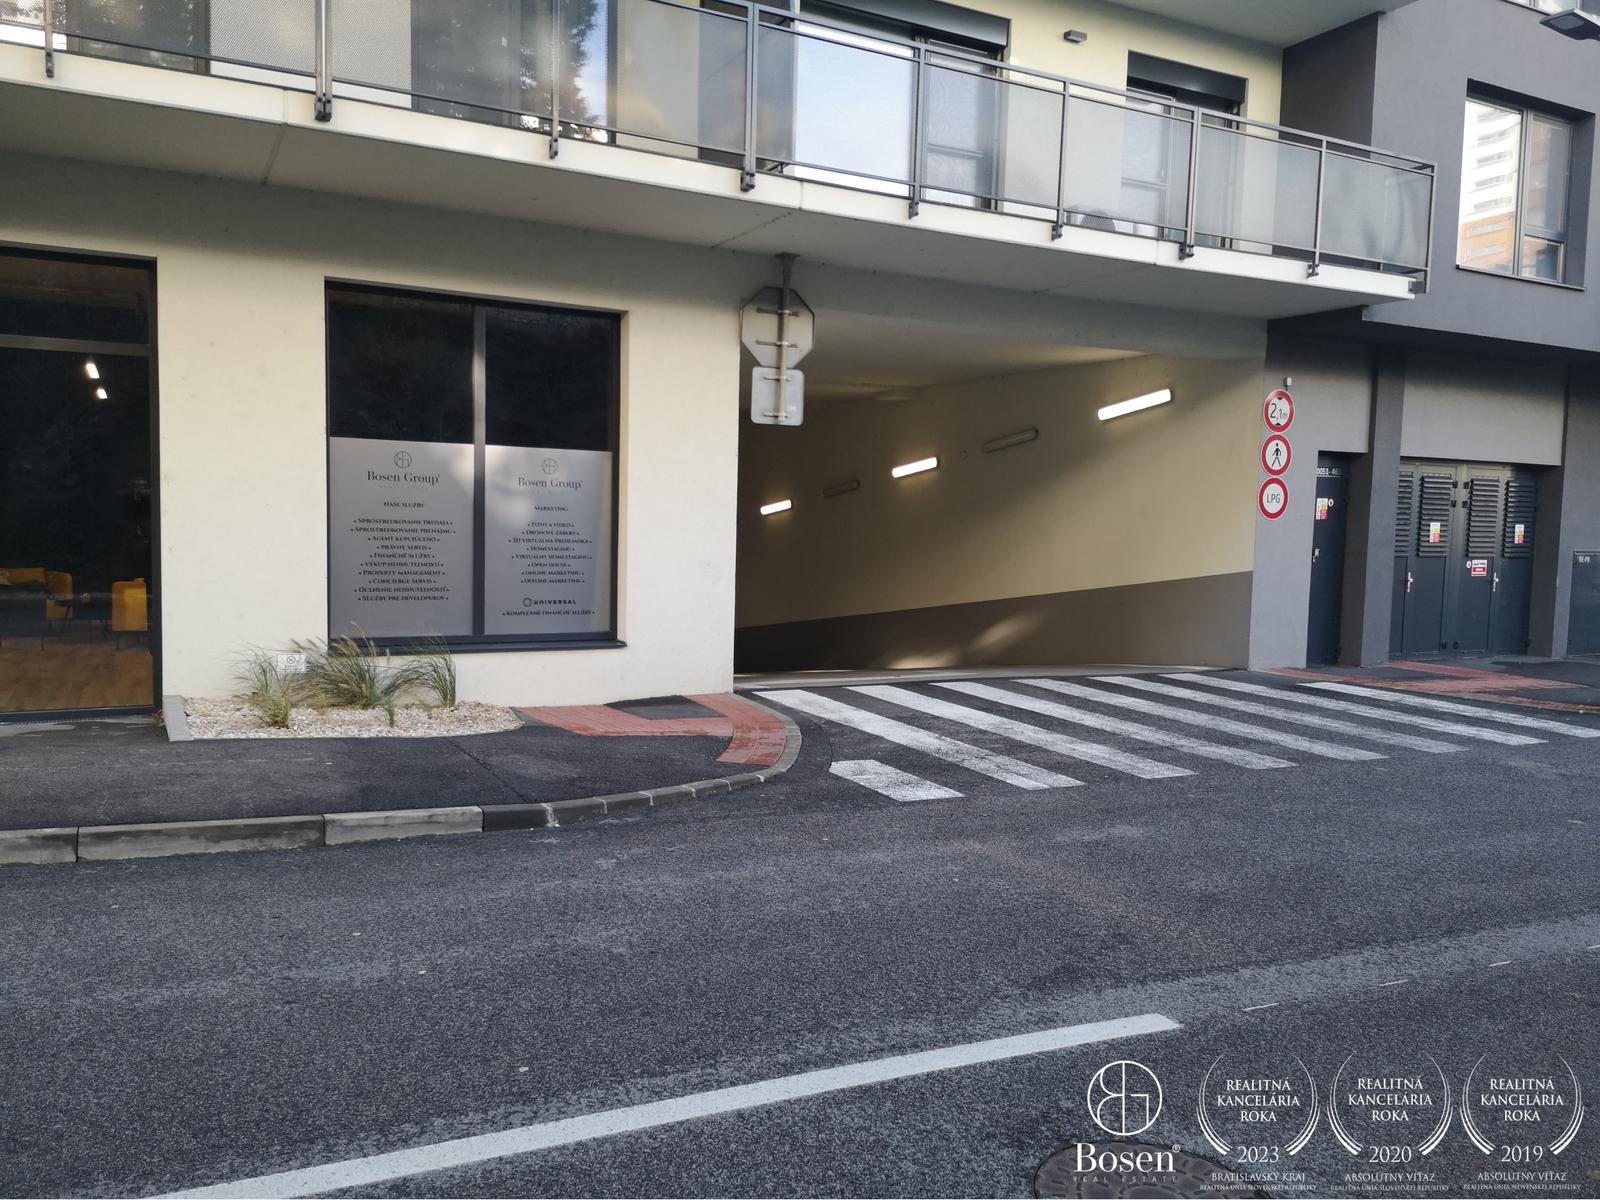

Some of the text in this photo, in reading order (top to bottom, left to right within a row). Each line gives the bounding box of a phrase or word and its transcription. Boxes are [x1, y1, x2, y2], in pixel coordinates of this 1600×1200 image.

[367, 471, 438, 485] Bosen Group
[518, 477, 581, 491] Bosen Group
[1266, 493, 1280, 503] LPG
